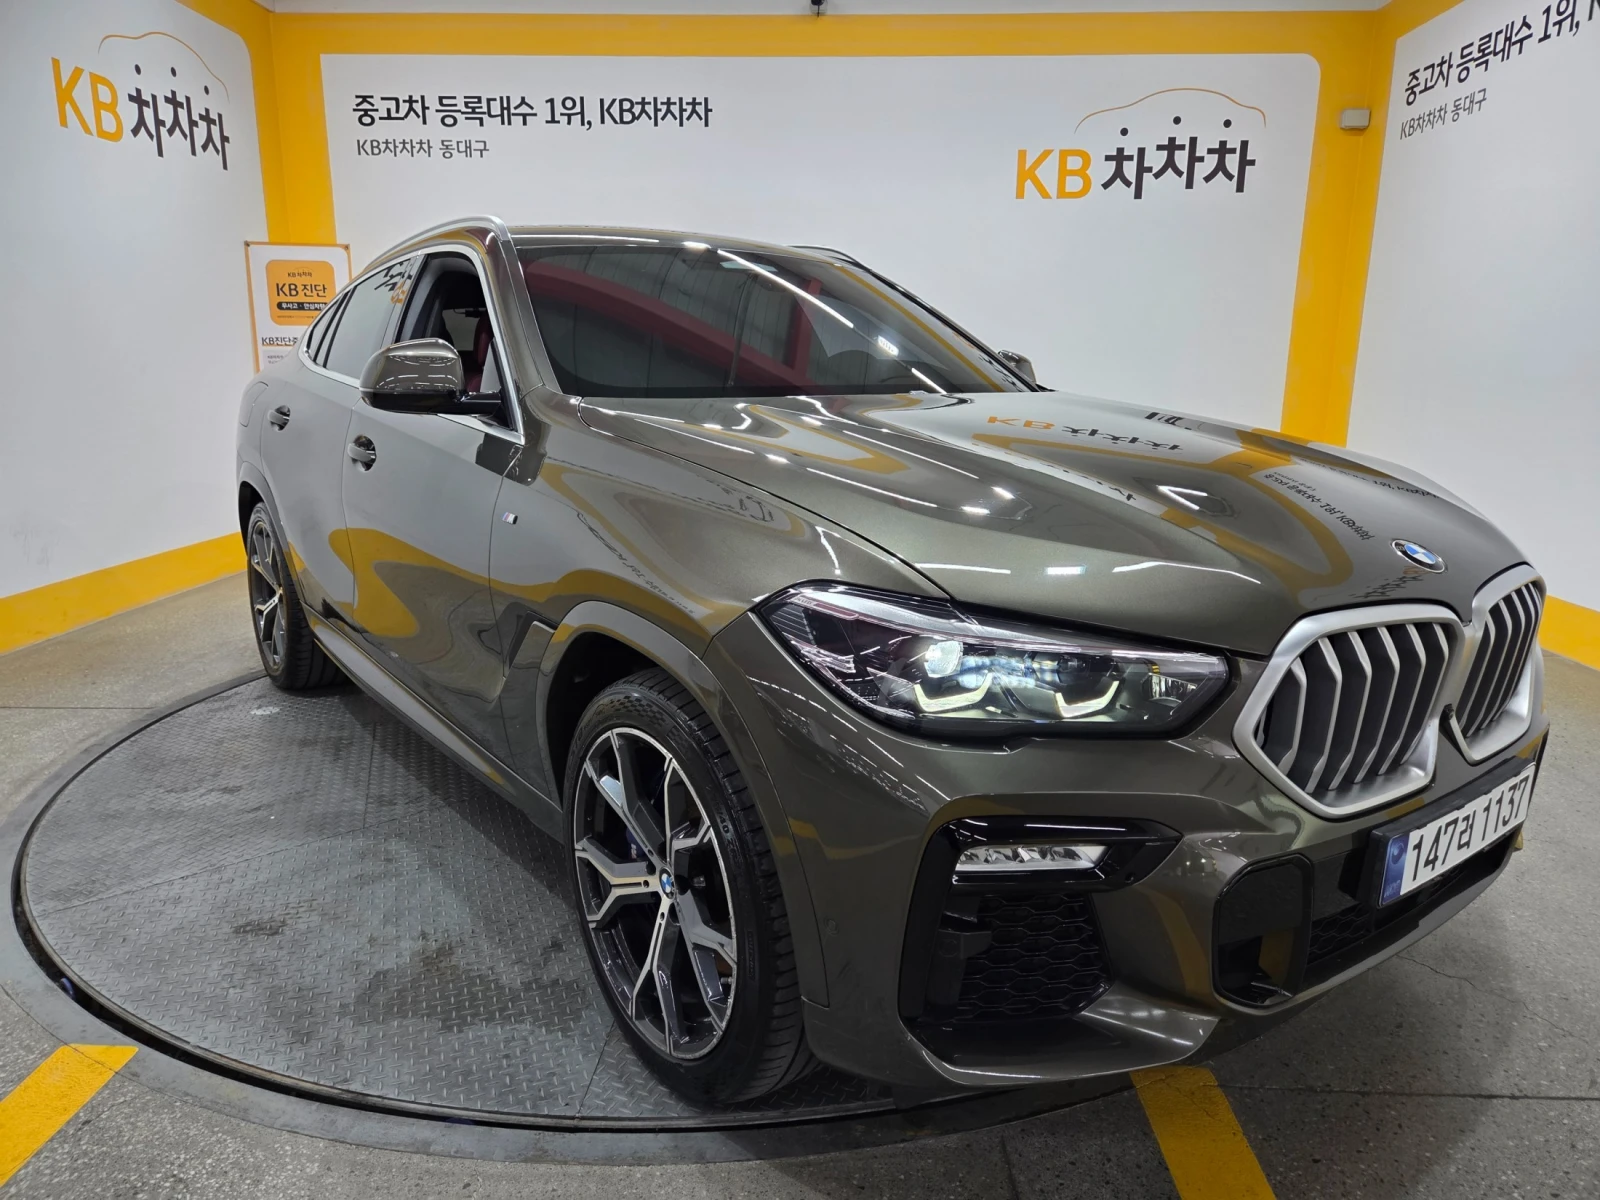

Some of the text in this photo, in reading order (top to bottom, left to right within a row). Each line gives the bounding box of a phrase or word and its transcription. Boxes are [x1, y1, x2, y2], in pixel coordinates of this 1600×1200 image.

[1405, 0, 1580, 106] 중고차 등록대수 1위,
[51, 57, 231, 171] KB 차차차
[353, 95, 713, 131] 중고차 등록대수 1위, KB차차차
[1400, 88, 1487, 140] KB차차차 동대구
[356, 139, 490, 159] KB차차차 동대구
[1015, 115, 1256, 200] KB 차차차
[276, 283, 328, 298] KB 진단
[1412, 774, 1530, 882] 147러 1137
